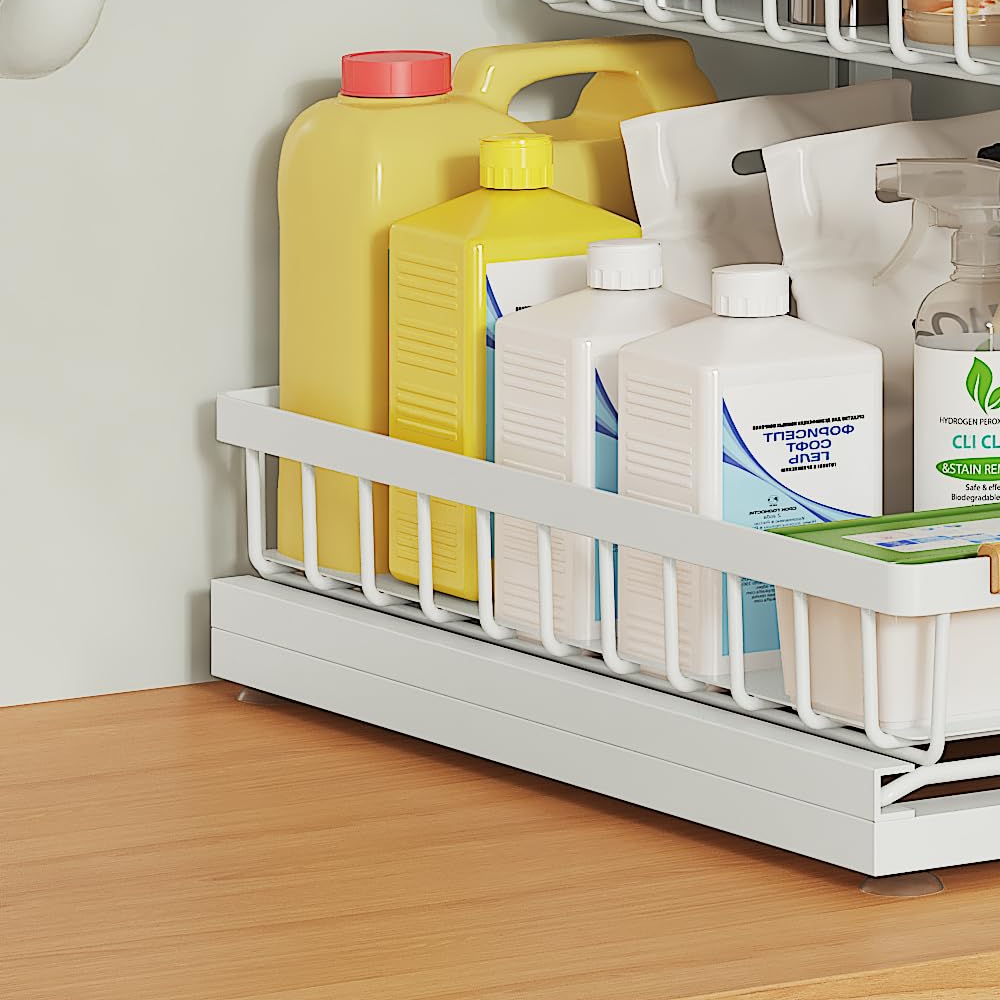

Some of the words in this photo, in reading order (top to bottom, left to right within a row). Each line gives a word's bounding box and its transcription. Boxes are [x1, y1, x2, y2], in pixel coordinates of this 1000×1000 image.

[939, 417, 978, 426] HYDROGEN
[952, 434, 976, 449] CLI
[942, 462, 981, 475] &STAIN
[951, 494, 1000, 502] Biodegradable
